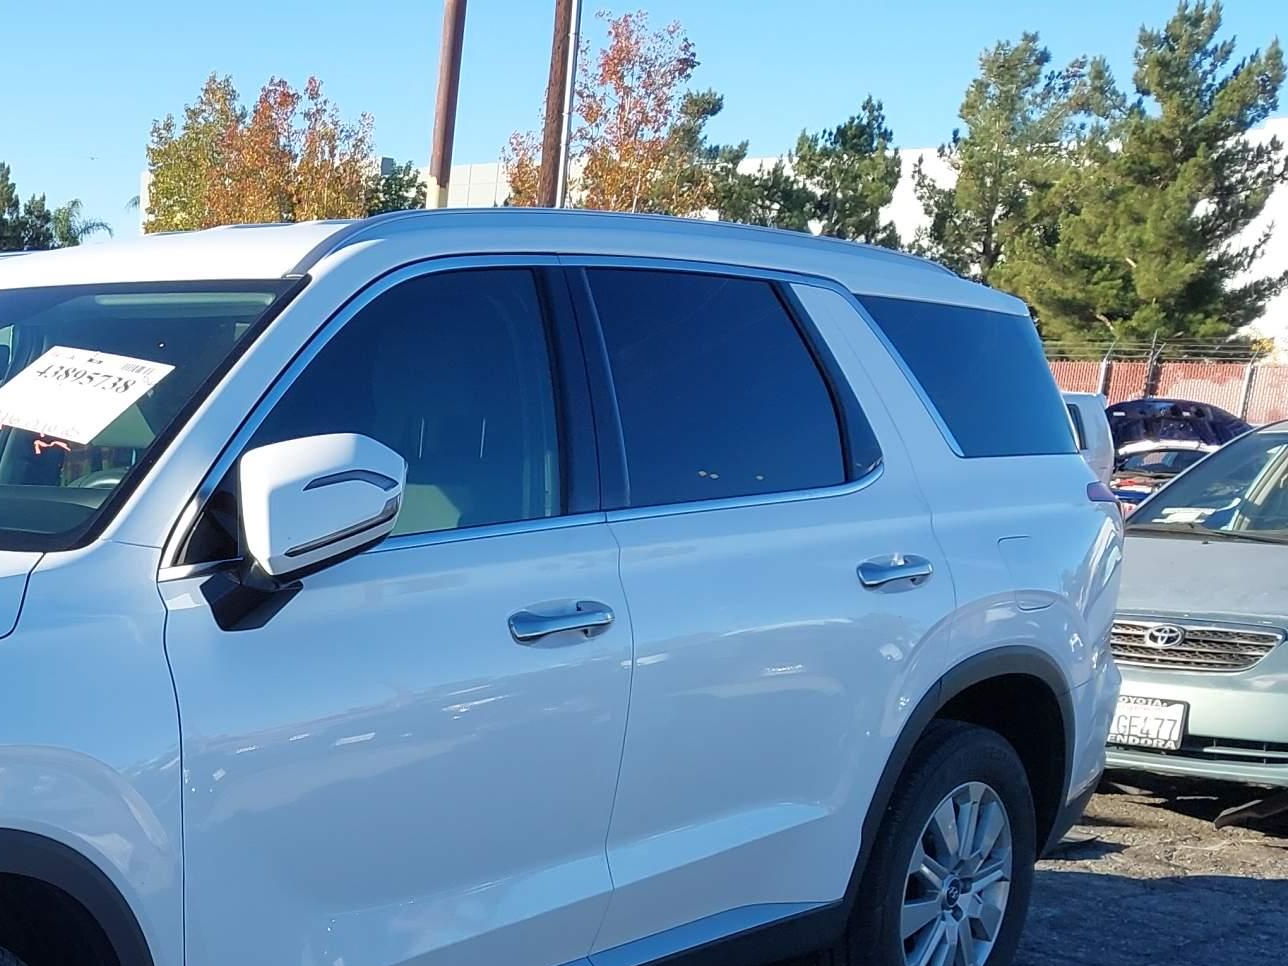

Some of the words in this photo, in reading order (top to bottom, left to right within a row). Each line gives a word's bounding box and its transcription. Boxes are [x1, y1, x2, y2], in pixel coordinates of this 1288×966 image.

[36, 364, 137, 394] 43895738
[1119, 696, 1162, 706] OYOTA
[1116, 714, 1178, 742] GE477
[1106, 734, 1176, 750] ENDORA
